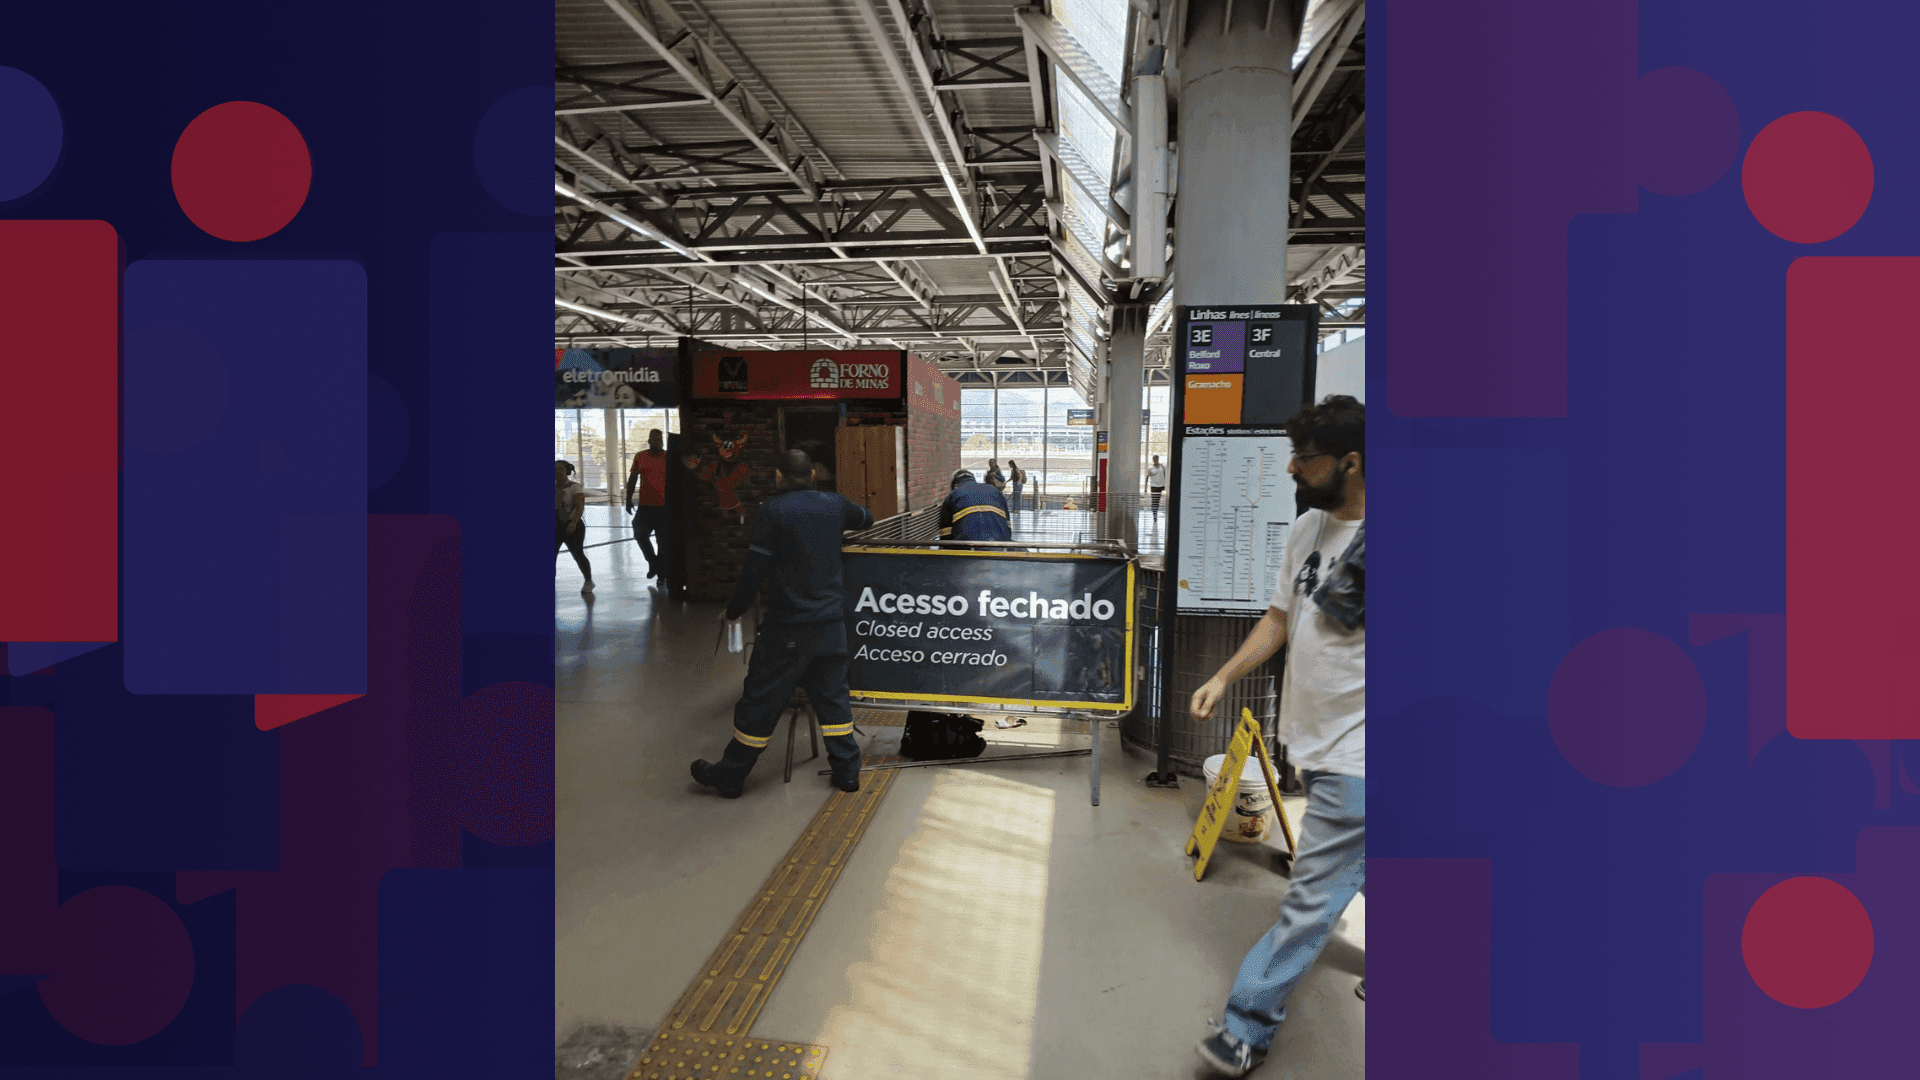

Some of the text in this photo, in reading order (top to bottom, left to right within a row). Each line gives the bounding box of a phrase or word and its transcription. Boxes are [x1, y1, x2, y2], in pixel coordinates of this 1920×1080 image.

[1190, 310, 1226, 320] Linhas
[1191, 329, 1212, 343] 3E
[1251, 328, 1272, 342] 3F
[1188, 350, 1221, 359] Belford
[1249, 349, 1281, 358] Central
[839, 364, 889, 378] FORNO
[1188, 361, 1211, 370] Roxo
[562, 366, 660, 386] eletromidia
[840, 379, 889, 389] DE MINAS
[1187, 380, 1232, 389] Gramacho
[1185, 426, 1225, 436] Estações
[854, 586, 1116, 621] Acesso fechado
[855, 620, 994, 641] Closed access
[853, 644, 1008, 667] Acceso cerrado
